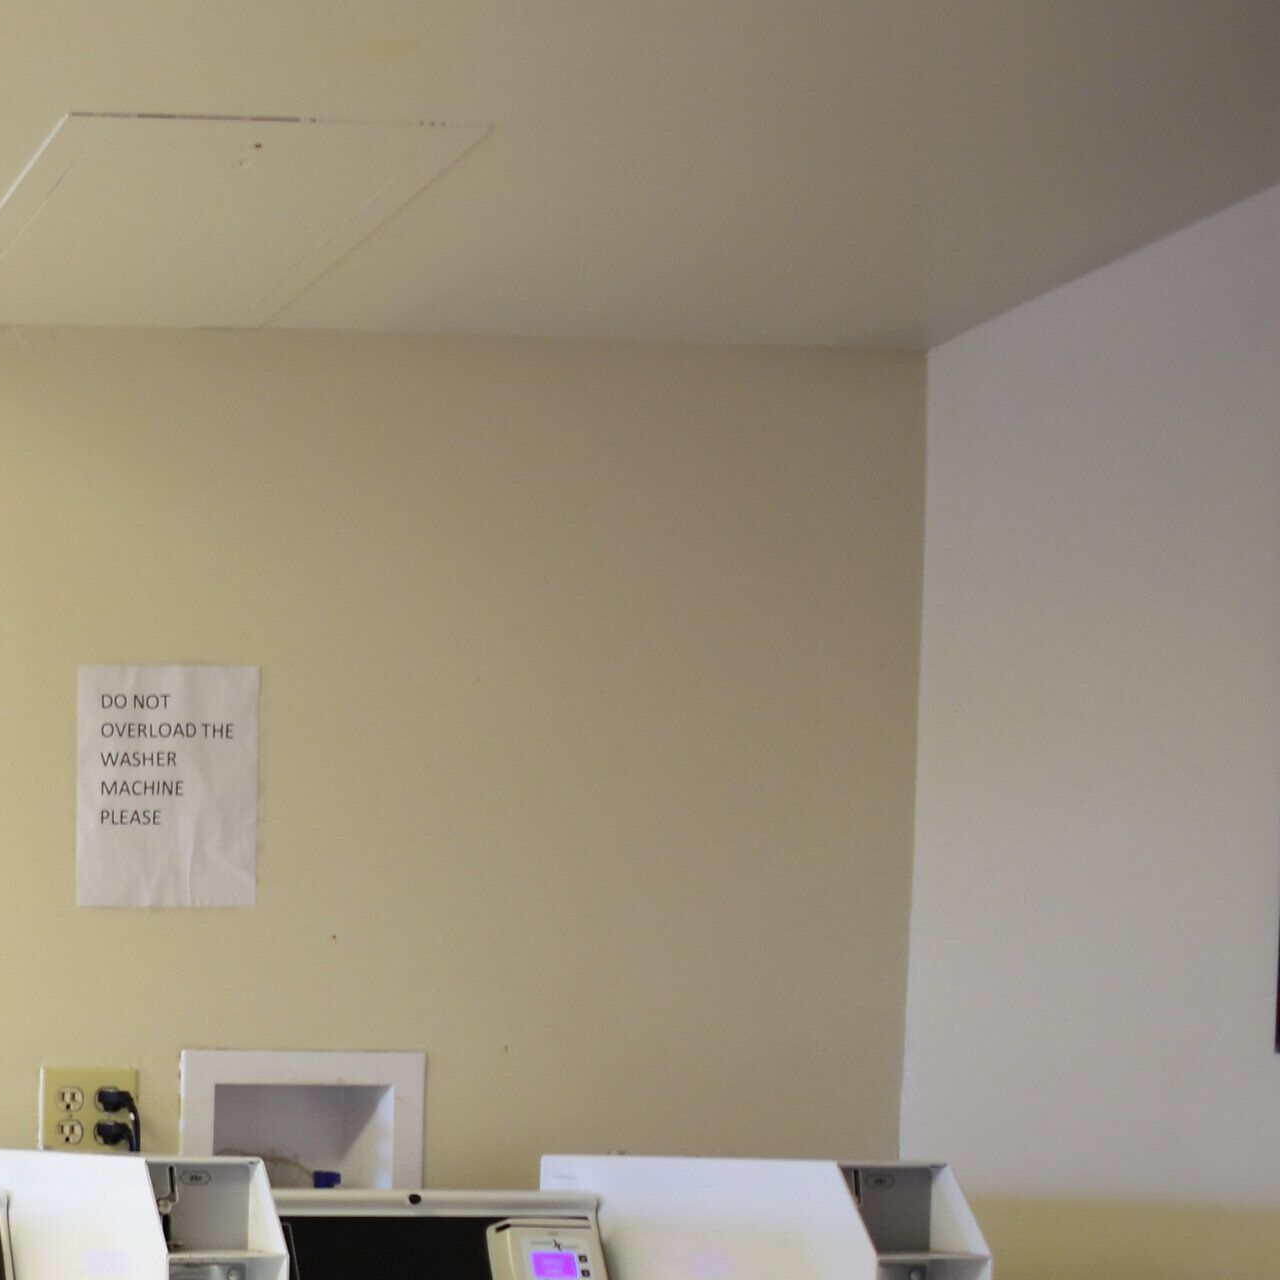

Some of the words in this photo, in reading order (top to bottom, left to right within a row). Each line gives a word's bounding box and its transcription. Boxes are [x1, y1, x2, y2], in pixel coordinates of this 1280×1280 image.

[102, 694, 127, 709] DO
[133, 694, 171, 709] NOT
[101, 723, 197, 738] OVERLOAD
[202, 723, 234, 739] THE
[101, 751, 177, 767] WASHER
[101, 780, 184, 796] MACHINE
[100, 809, 161, 825] PLEASE
